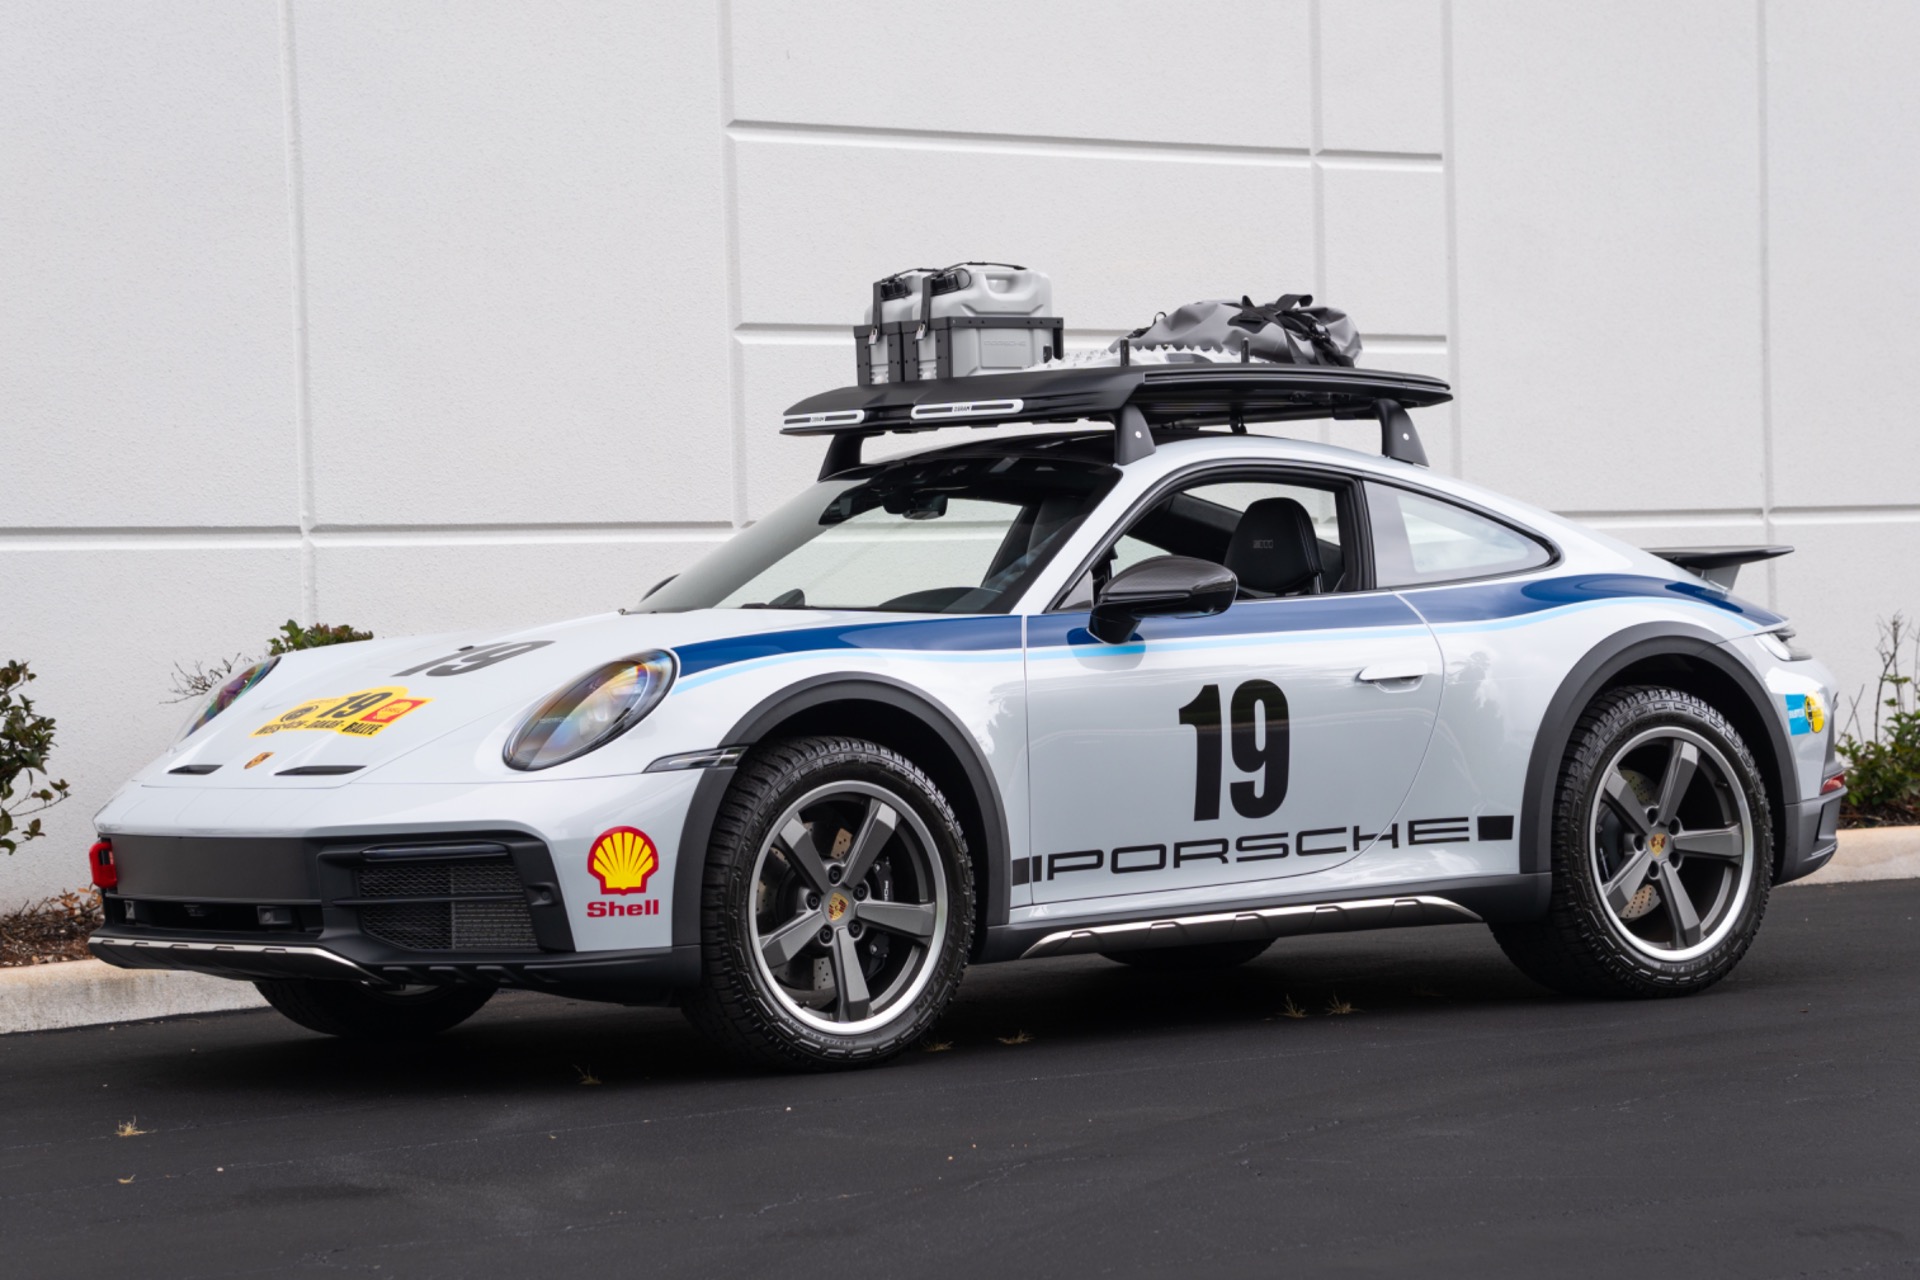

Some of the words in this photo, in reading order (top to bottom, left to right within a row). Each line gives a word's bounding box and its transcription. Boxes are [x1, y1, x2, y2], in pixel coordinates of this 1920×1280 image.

[390, 640, 556, 678] 19
[316, 692, 393, 718] 19
[1178, 678, 1290, 822] 19
[1047, 816, 1470, 881] PORSCHE
[586, 899, 659, 918] Shell
